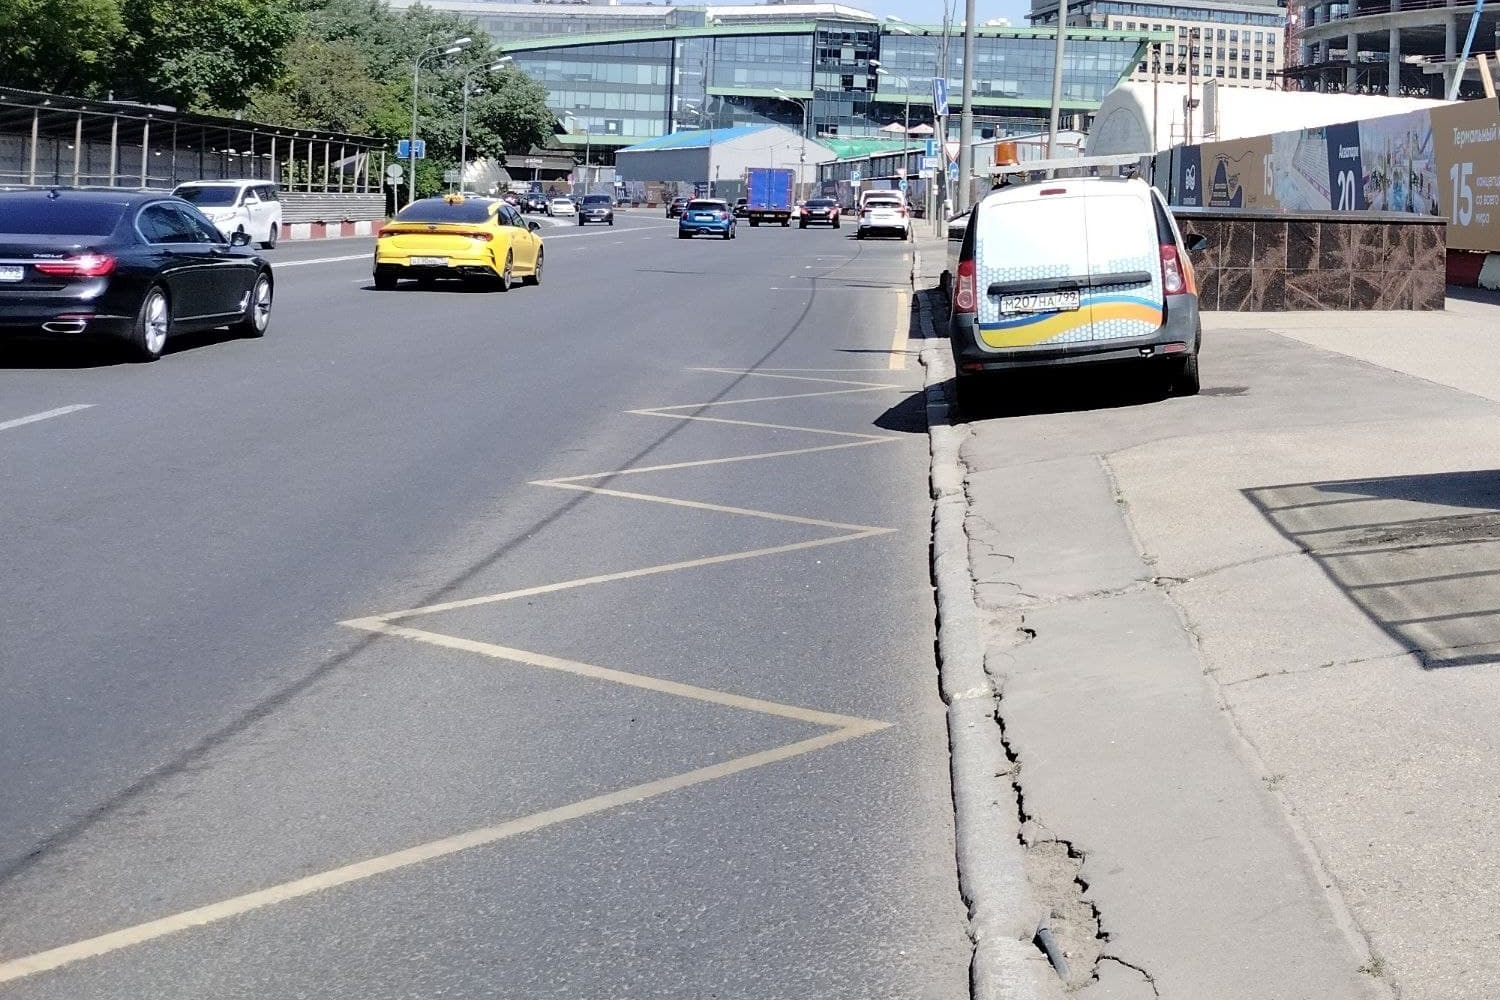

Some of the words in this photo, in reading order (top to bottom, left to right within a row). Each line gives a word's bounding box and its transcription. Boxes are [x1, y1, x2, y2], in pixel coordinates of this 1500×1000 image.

[1453, 122, 1497, 148] Термальный
[1338, 170, 1355, 211] 20
[1450, 162, 1473, 227] 15
[1058, 292, 1076, 303] 799
